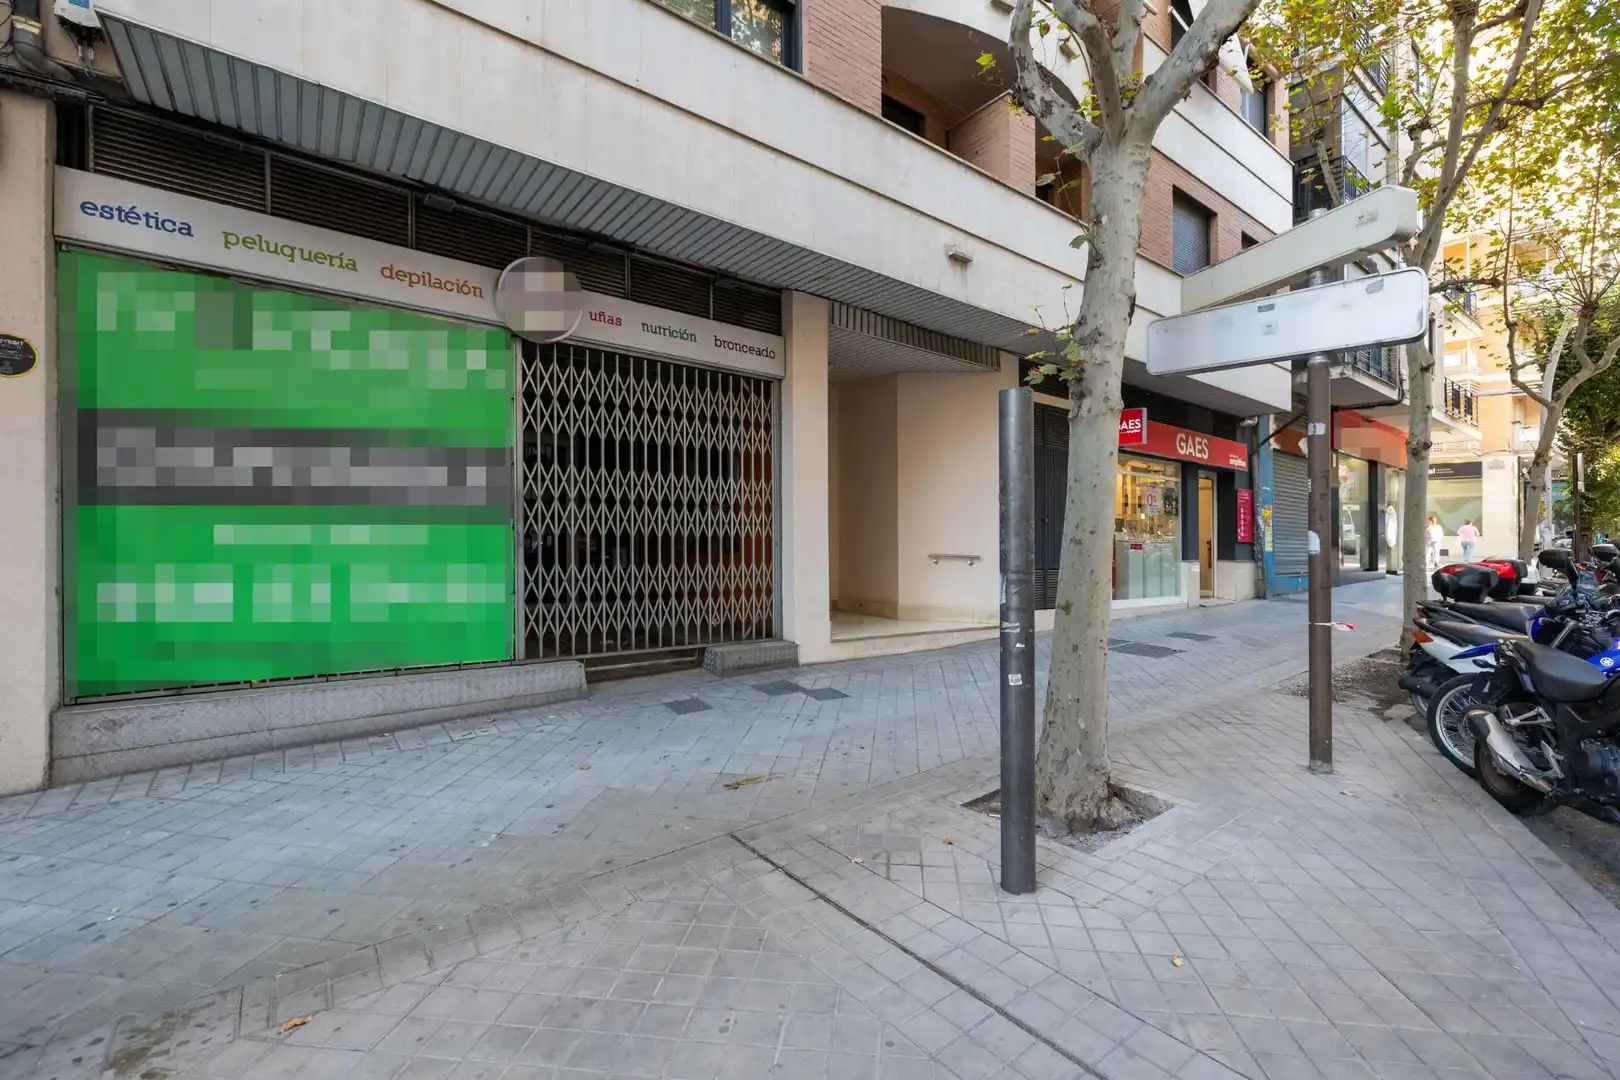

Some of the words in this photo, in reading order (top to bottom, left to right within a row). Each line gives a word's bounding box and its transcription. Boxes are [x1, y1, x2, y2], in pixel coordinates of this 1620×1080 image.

[80, 201, 194, 237] estética
[221, 230, 359, 272] peluquería
[380, 263, 484, 298] depilación
[588, 310, 622, 327] uñas
[640, 321, 697, 343] nutrición
[713, 334, 776, 359] bronceado
[1118, 419, 1141, 430] AES
[1176, 433, 1208, 459] GAES
